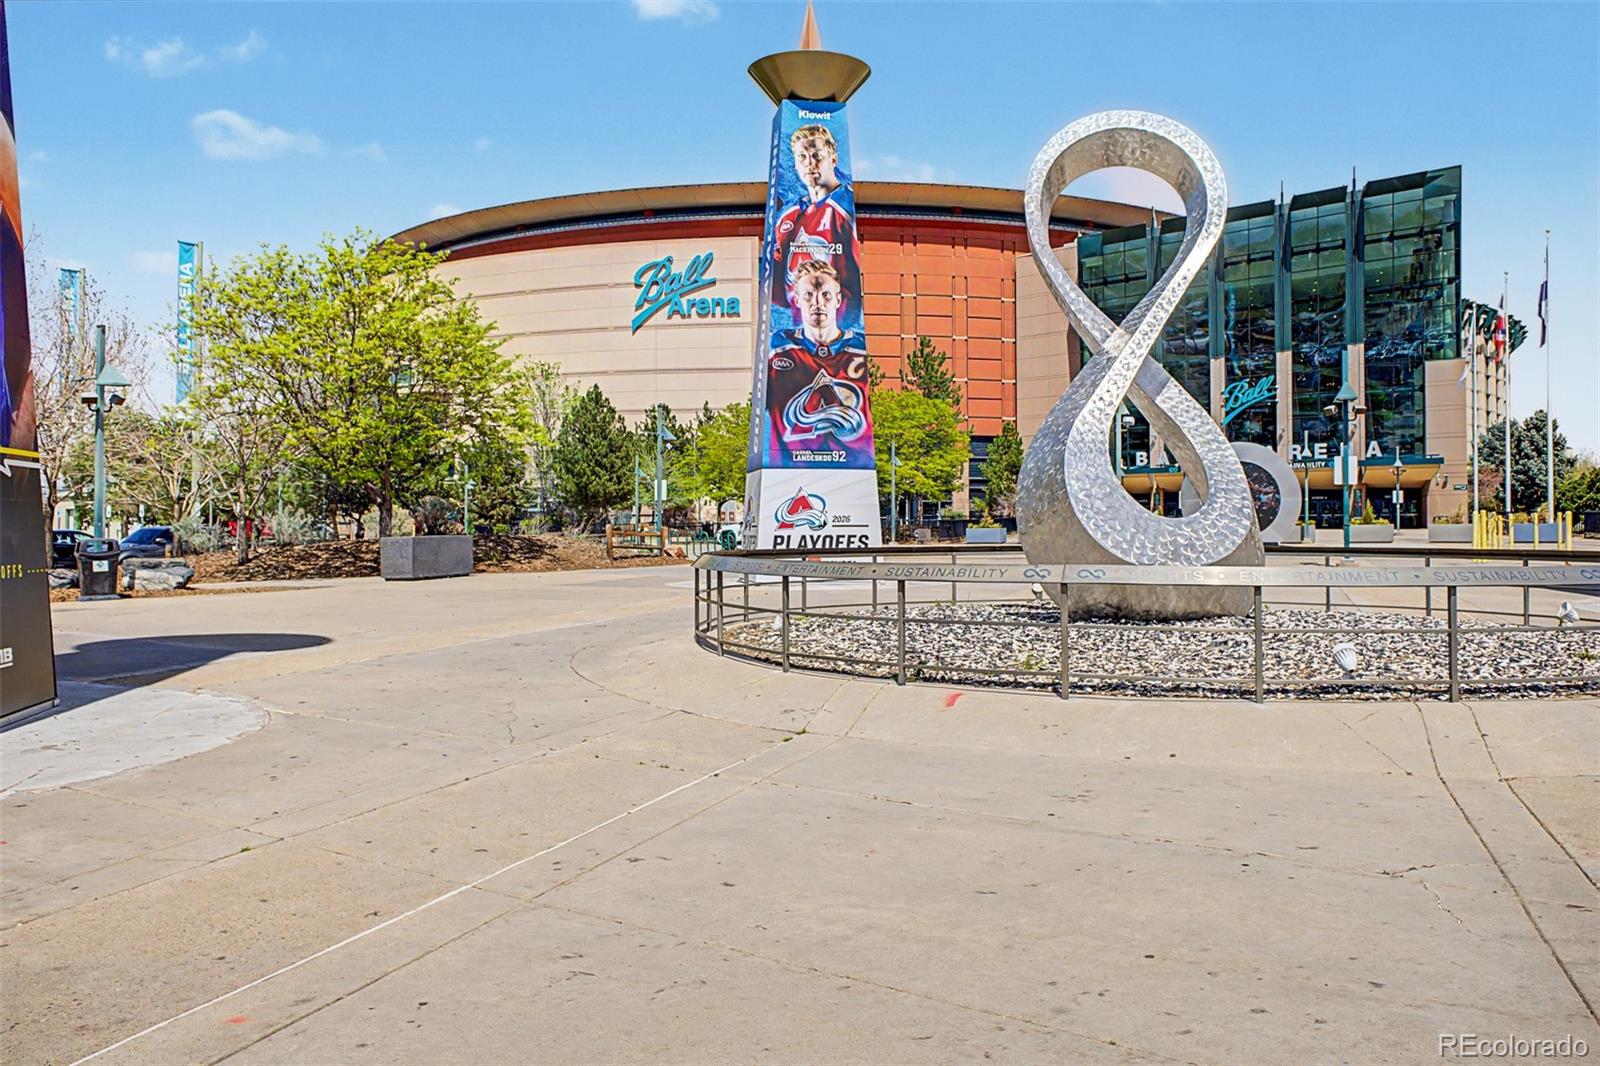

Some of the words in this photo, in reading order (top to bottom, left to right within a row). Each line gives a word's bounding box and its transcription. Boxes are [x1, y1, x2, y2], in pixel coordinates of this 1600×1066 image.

[829, 243, 843, 255] 29
[633, 251, 716, 313] Ball
[667, 294, 741, 319] Arena
[1222, 375, 1276, 413] Ball
[832, 450, 847, 462] 92
[832, 515, 851, 523] 2026
[772, 534, 869, 549] PLAYOFFS
[775, 563, 865, 576] ENTERTAINMENT
[885, 567, 1008, 578] SUSTAINABILITY
[1239, 570, 1400, 583] ENRTAINMENT
[1433, 570, 1567, 582] SUSTAINABILITY
